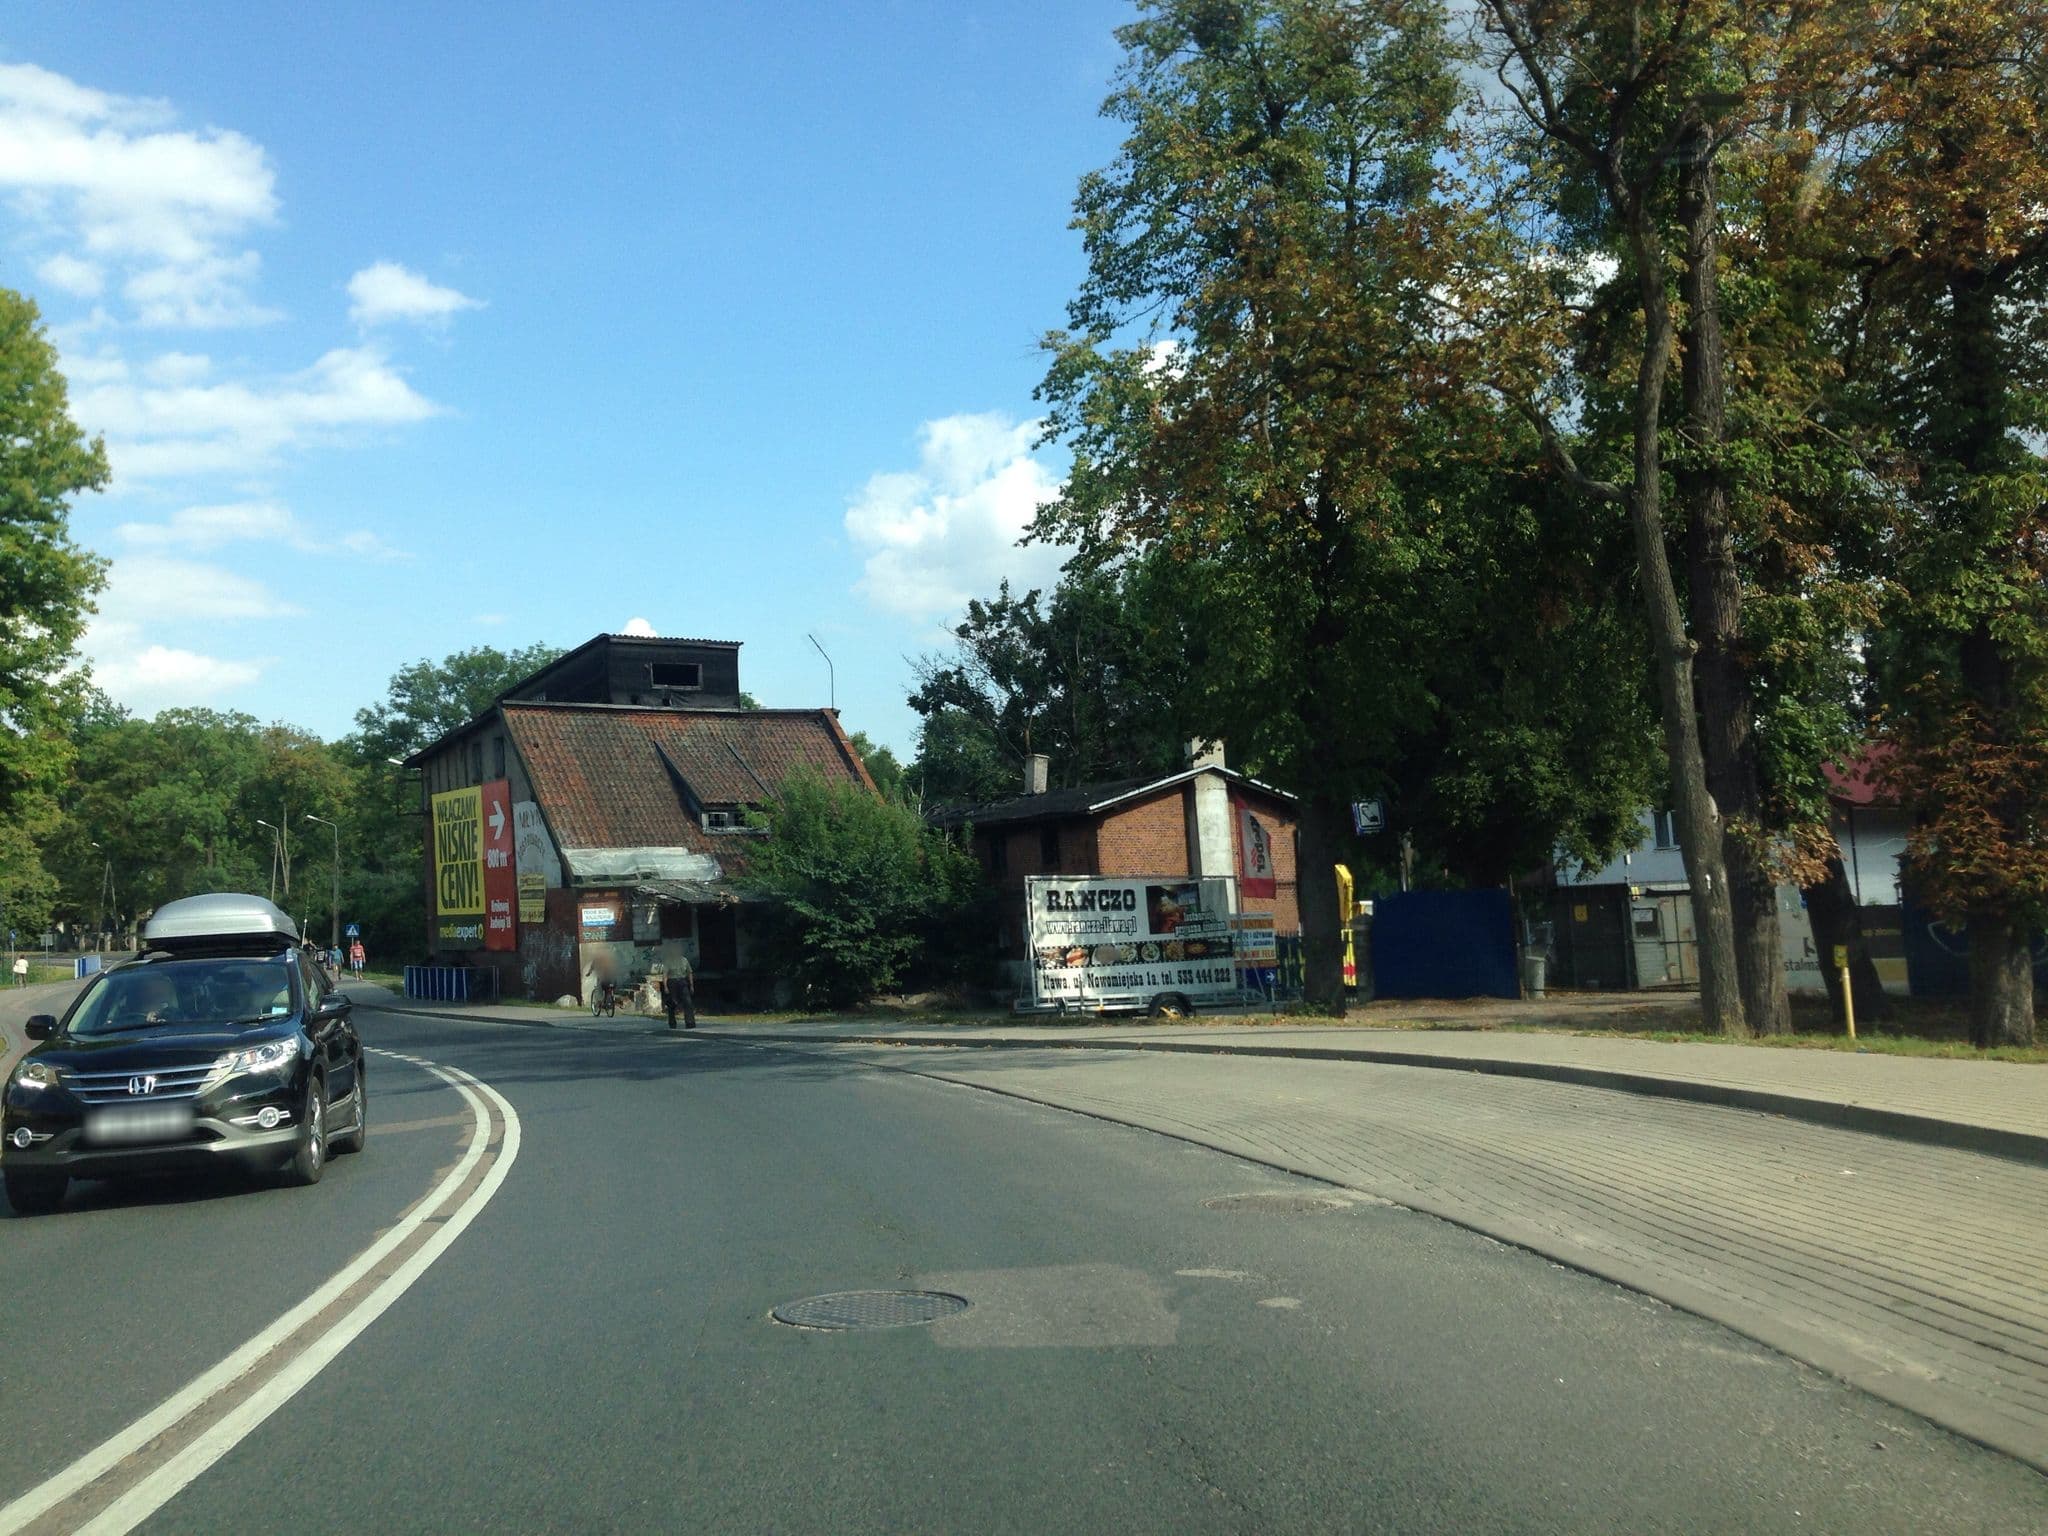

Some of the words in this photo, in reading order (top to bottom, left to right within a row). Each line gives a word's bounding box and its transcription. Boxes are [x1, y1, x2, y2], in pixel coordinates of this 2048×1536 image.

[438, 820, 478, 863] NISKIE
[440, 862, 480, 909] CENY!
[1046, 889, 1136, 912] RANCZO
[1087, 971, 1144, 989] Nowomiejska
[1161, 970, 1175, 985] tel.
[1196, 968, 1212, 983] 444
[1214, 967, 1231, 982] 222
